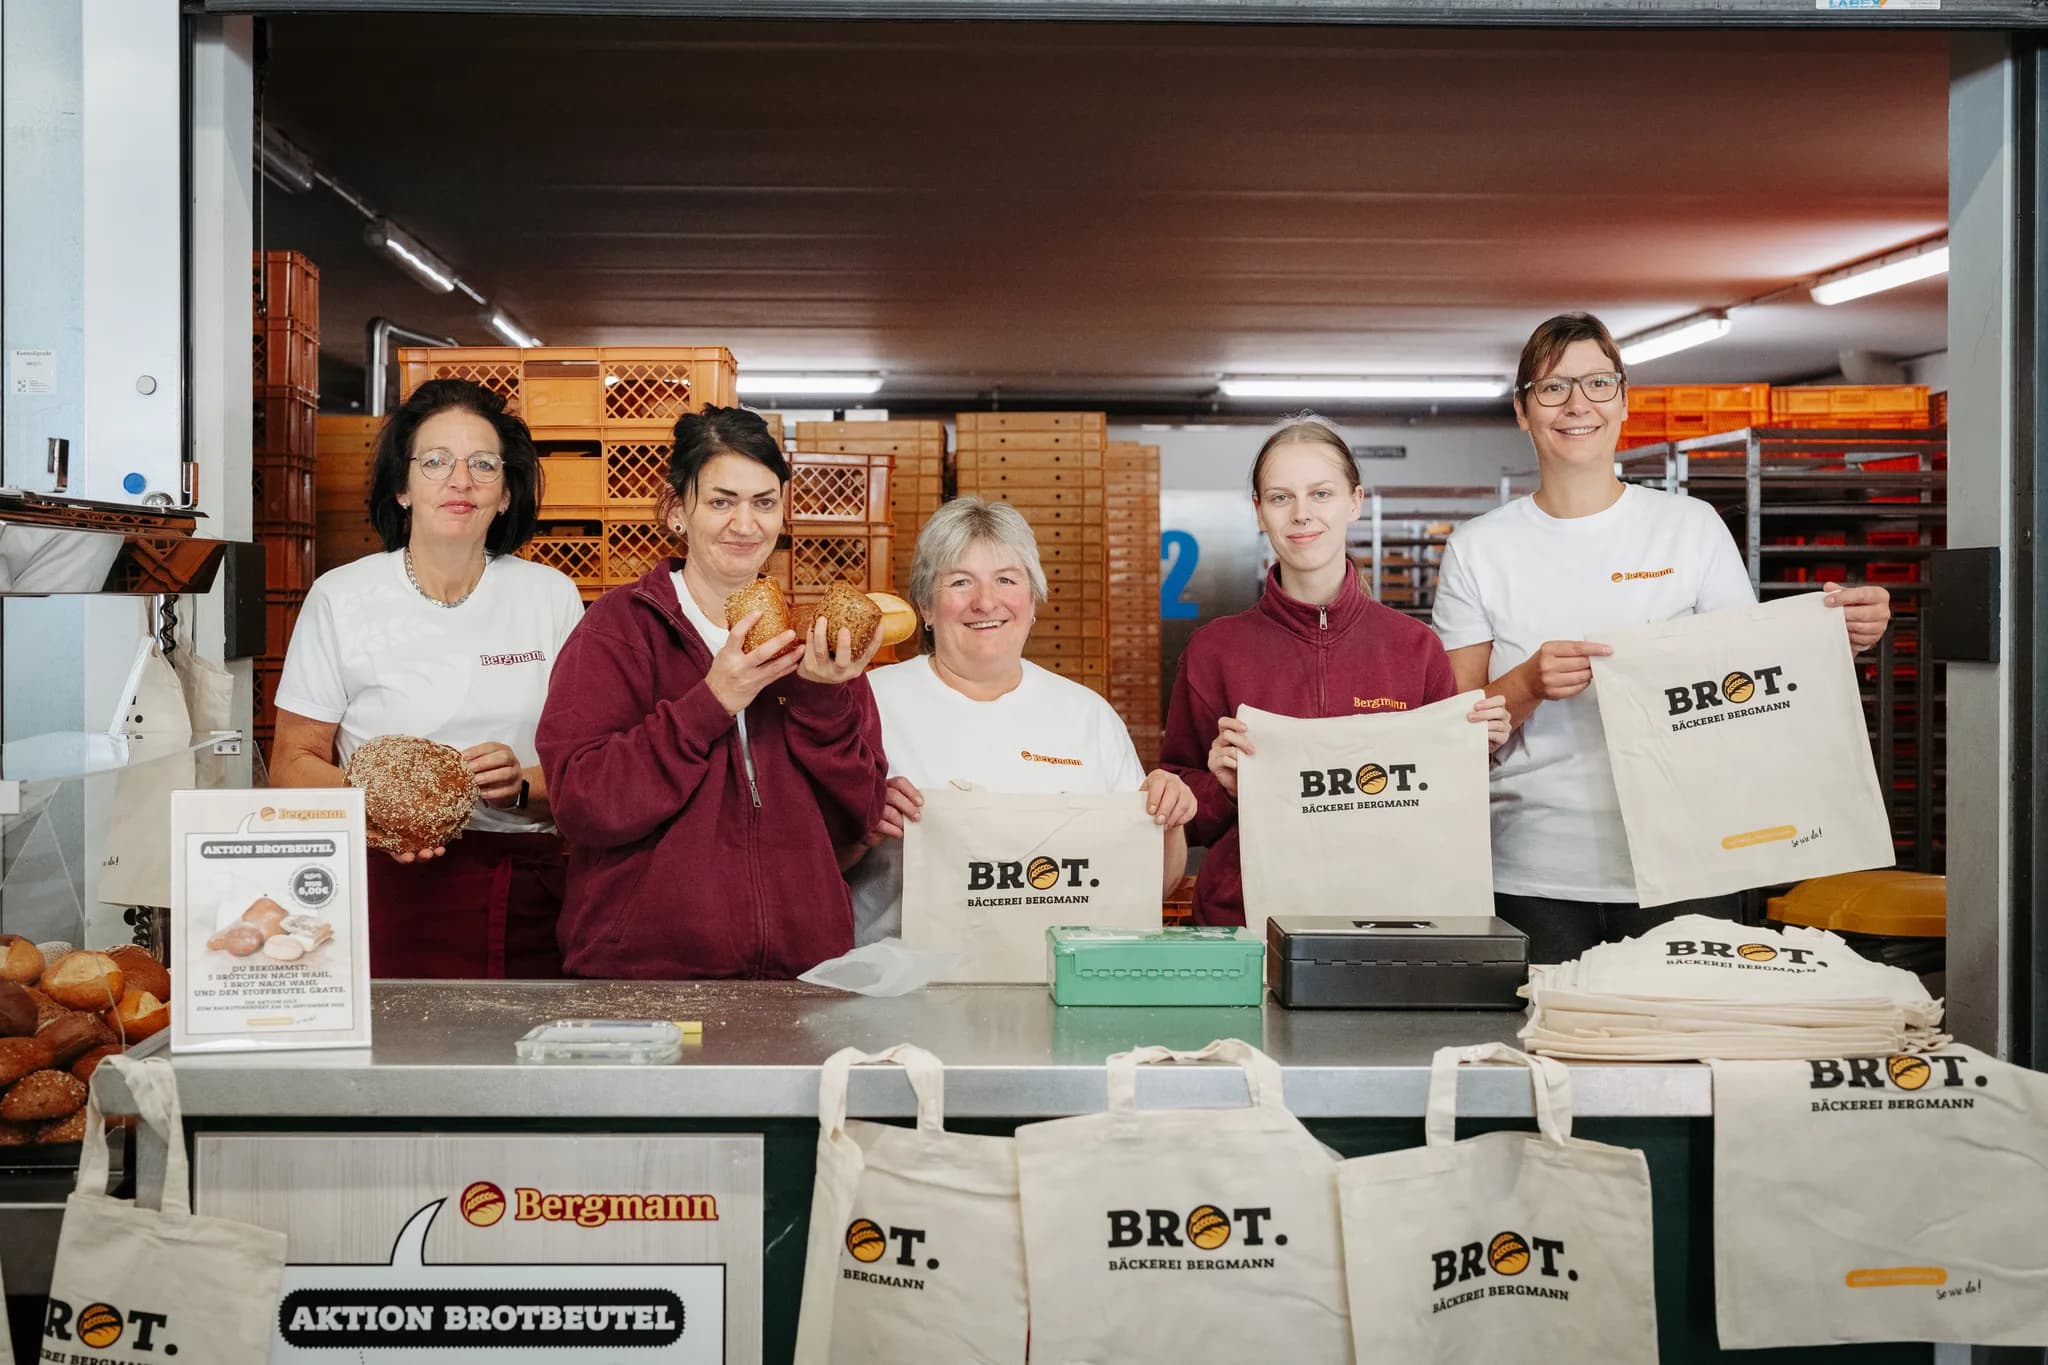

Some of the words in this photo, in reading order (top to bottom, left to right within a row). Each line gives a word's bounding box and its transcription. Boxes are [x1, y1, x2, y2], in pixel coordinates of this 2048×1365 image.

[1161, 530, 1199, 619] 2
[1664, 666, 1798, 716] BROT.
[1671, 713, 1725, 732] BÄCKEREI
[1727, 700, 1791, 720] BERGMANN
[1300, 763, 1428, 798] BROT.
[1302, 803, 1354, 814] BÄCKEREI
[1357, 799, 1419, 810] BERGMANN
[203, 844, 252, 855] AKTION
[255, 843, 333, 854] BROTBEUTEL
[968, 856, 1100, 890] BROT.
[968, 897, 1022, 907] BÄCKEREI
[1025, 895, 1089, 905] BERGMANN
[250, 964, 308, 972] BEKOMMST:
[1666, 940, 1828, 968] BROT.
[1666, 960, 1733, 969] BÄCKEREI
[216, 972, 268, 980] BRÖTCHEN
[242, 987, 307, 996] STOFFBEUTEL
[309, 986, 346, 994] GRATIS.
[1805, 1055, 1988, 1091] BROT.
[1811, 1099, 1882, 1112] BÄCKEREI
[1888, 1098, 1974, 1110] BERGMANN
[515, 1188, 719, 1228] Bergmann
[1107, 1204, 1288, 1250] BROT.
[844, 1218, 940, 1270] OT.
[1108, 1257, 1182, 1271] BÄCKEREI
[1187, 1258, 1275, 1270] BERGMANN
[1431, 1231, 1579, 1291] BROT.
[843, 1269, 924, 1291] BERGMANN
[1432, 1288, 1485, 1314] BÄCKEREI
[1488, 1285, 1569, 1301] BERGMANN
[289, 1305, 434, 1332] AKTION
[443, 1304, 676, 1332] BROTBEUTEL
